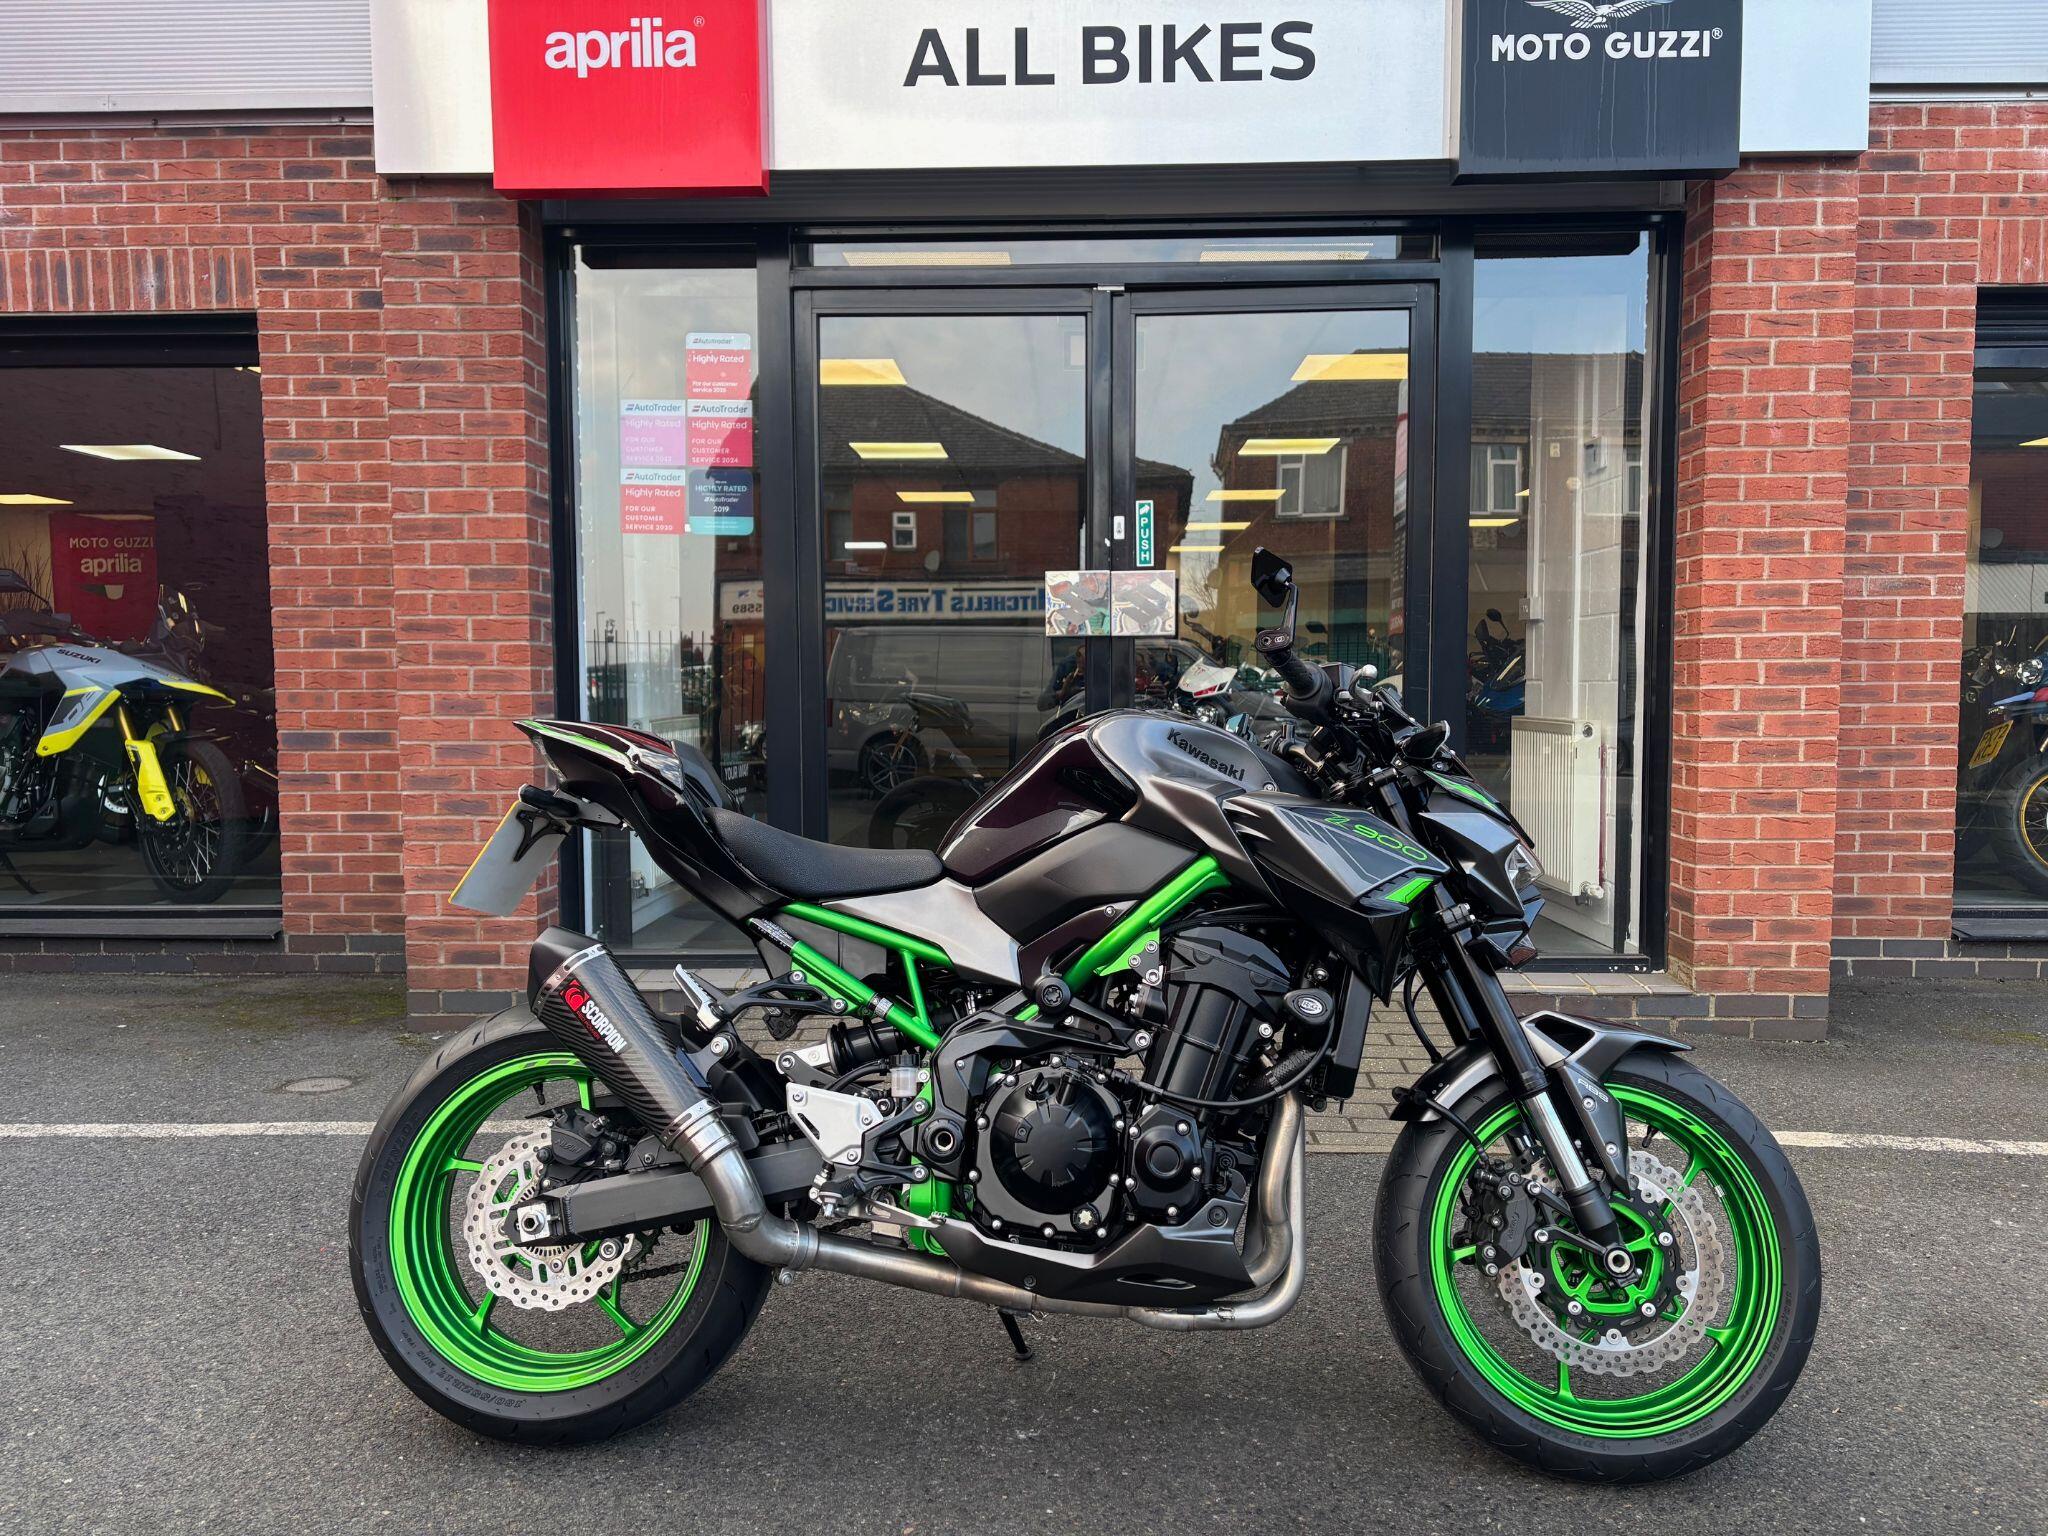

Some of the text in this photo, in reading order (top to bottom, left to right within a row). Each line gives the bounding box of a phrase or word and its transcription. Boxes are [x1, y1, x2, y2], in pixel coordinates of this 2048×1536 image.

[544, 17, 697, 79] aprilia
[902, 20, 1316, 87] ALL BIKES
[1491, 30, 1711, 62] MOTO GUZZI
[692, 354, 745, 364] Highly Rated
[634, 403, 681, 412] AutoTrader
[700, 405, 748, 413] AutoTrader
[625, 420, 681, 430] Highly Rated
[691, 421, 748, 430] Highly Rated
[634, 473, 681, 481] AutoTrader
[625, 488, 681, 498] Highly Rated
[723, 485, 748, 493] RATED
[69, 537, 154, 549] MOTO GUZZI
[1140, 517, 1150, 562] PUSH
[80, 552, 142, 577] aprilia
[57, 648, 102, 664] SUZUKI
[1167, 727, 1246, 782] Kawasaki
[724, 762, 749, 781] YOUR WAY
[581, 1000, 628, 1053] SCORPION
[1578, 1078, 1609, 1103] ABS
